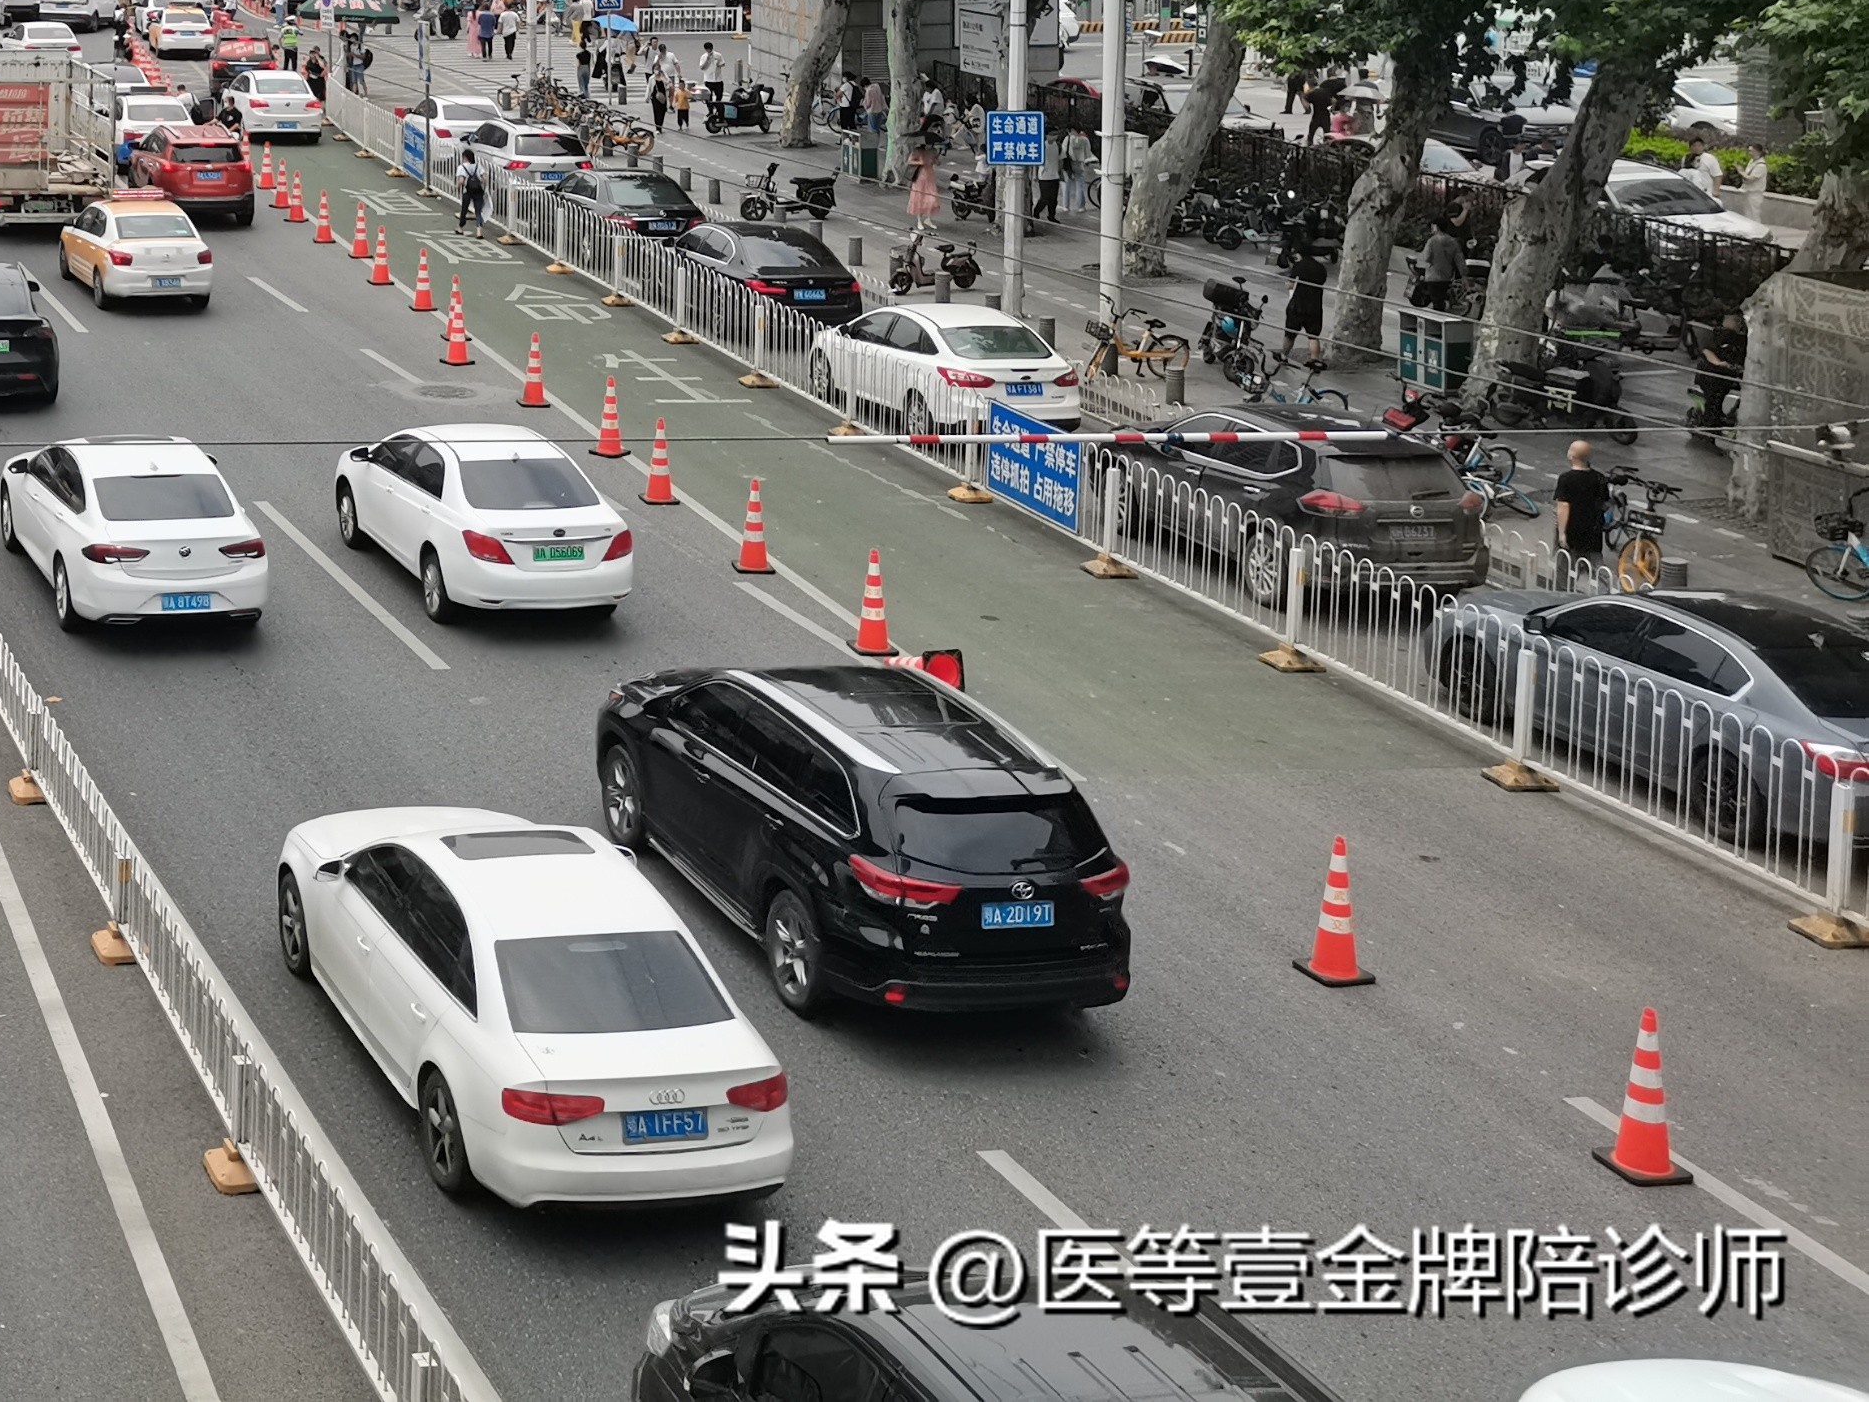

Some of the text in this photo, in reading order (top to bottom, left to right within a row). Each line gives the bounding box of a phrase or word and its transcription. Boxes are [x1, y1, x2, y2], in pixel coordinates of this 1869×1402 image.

[992, 116, 1039, 135] 生命通道
[992, 141, 1040, 160] 严禁停车
[990, 450, 1075, 517] 违停抓拍 占用拖移
